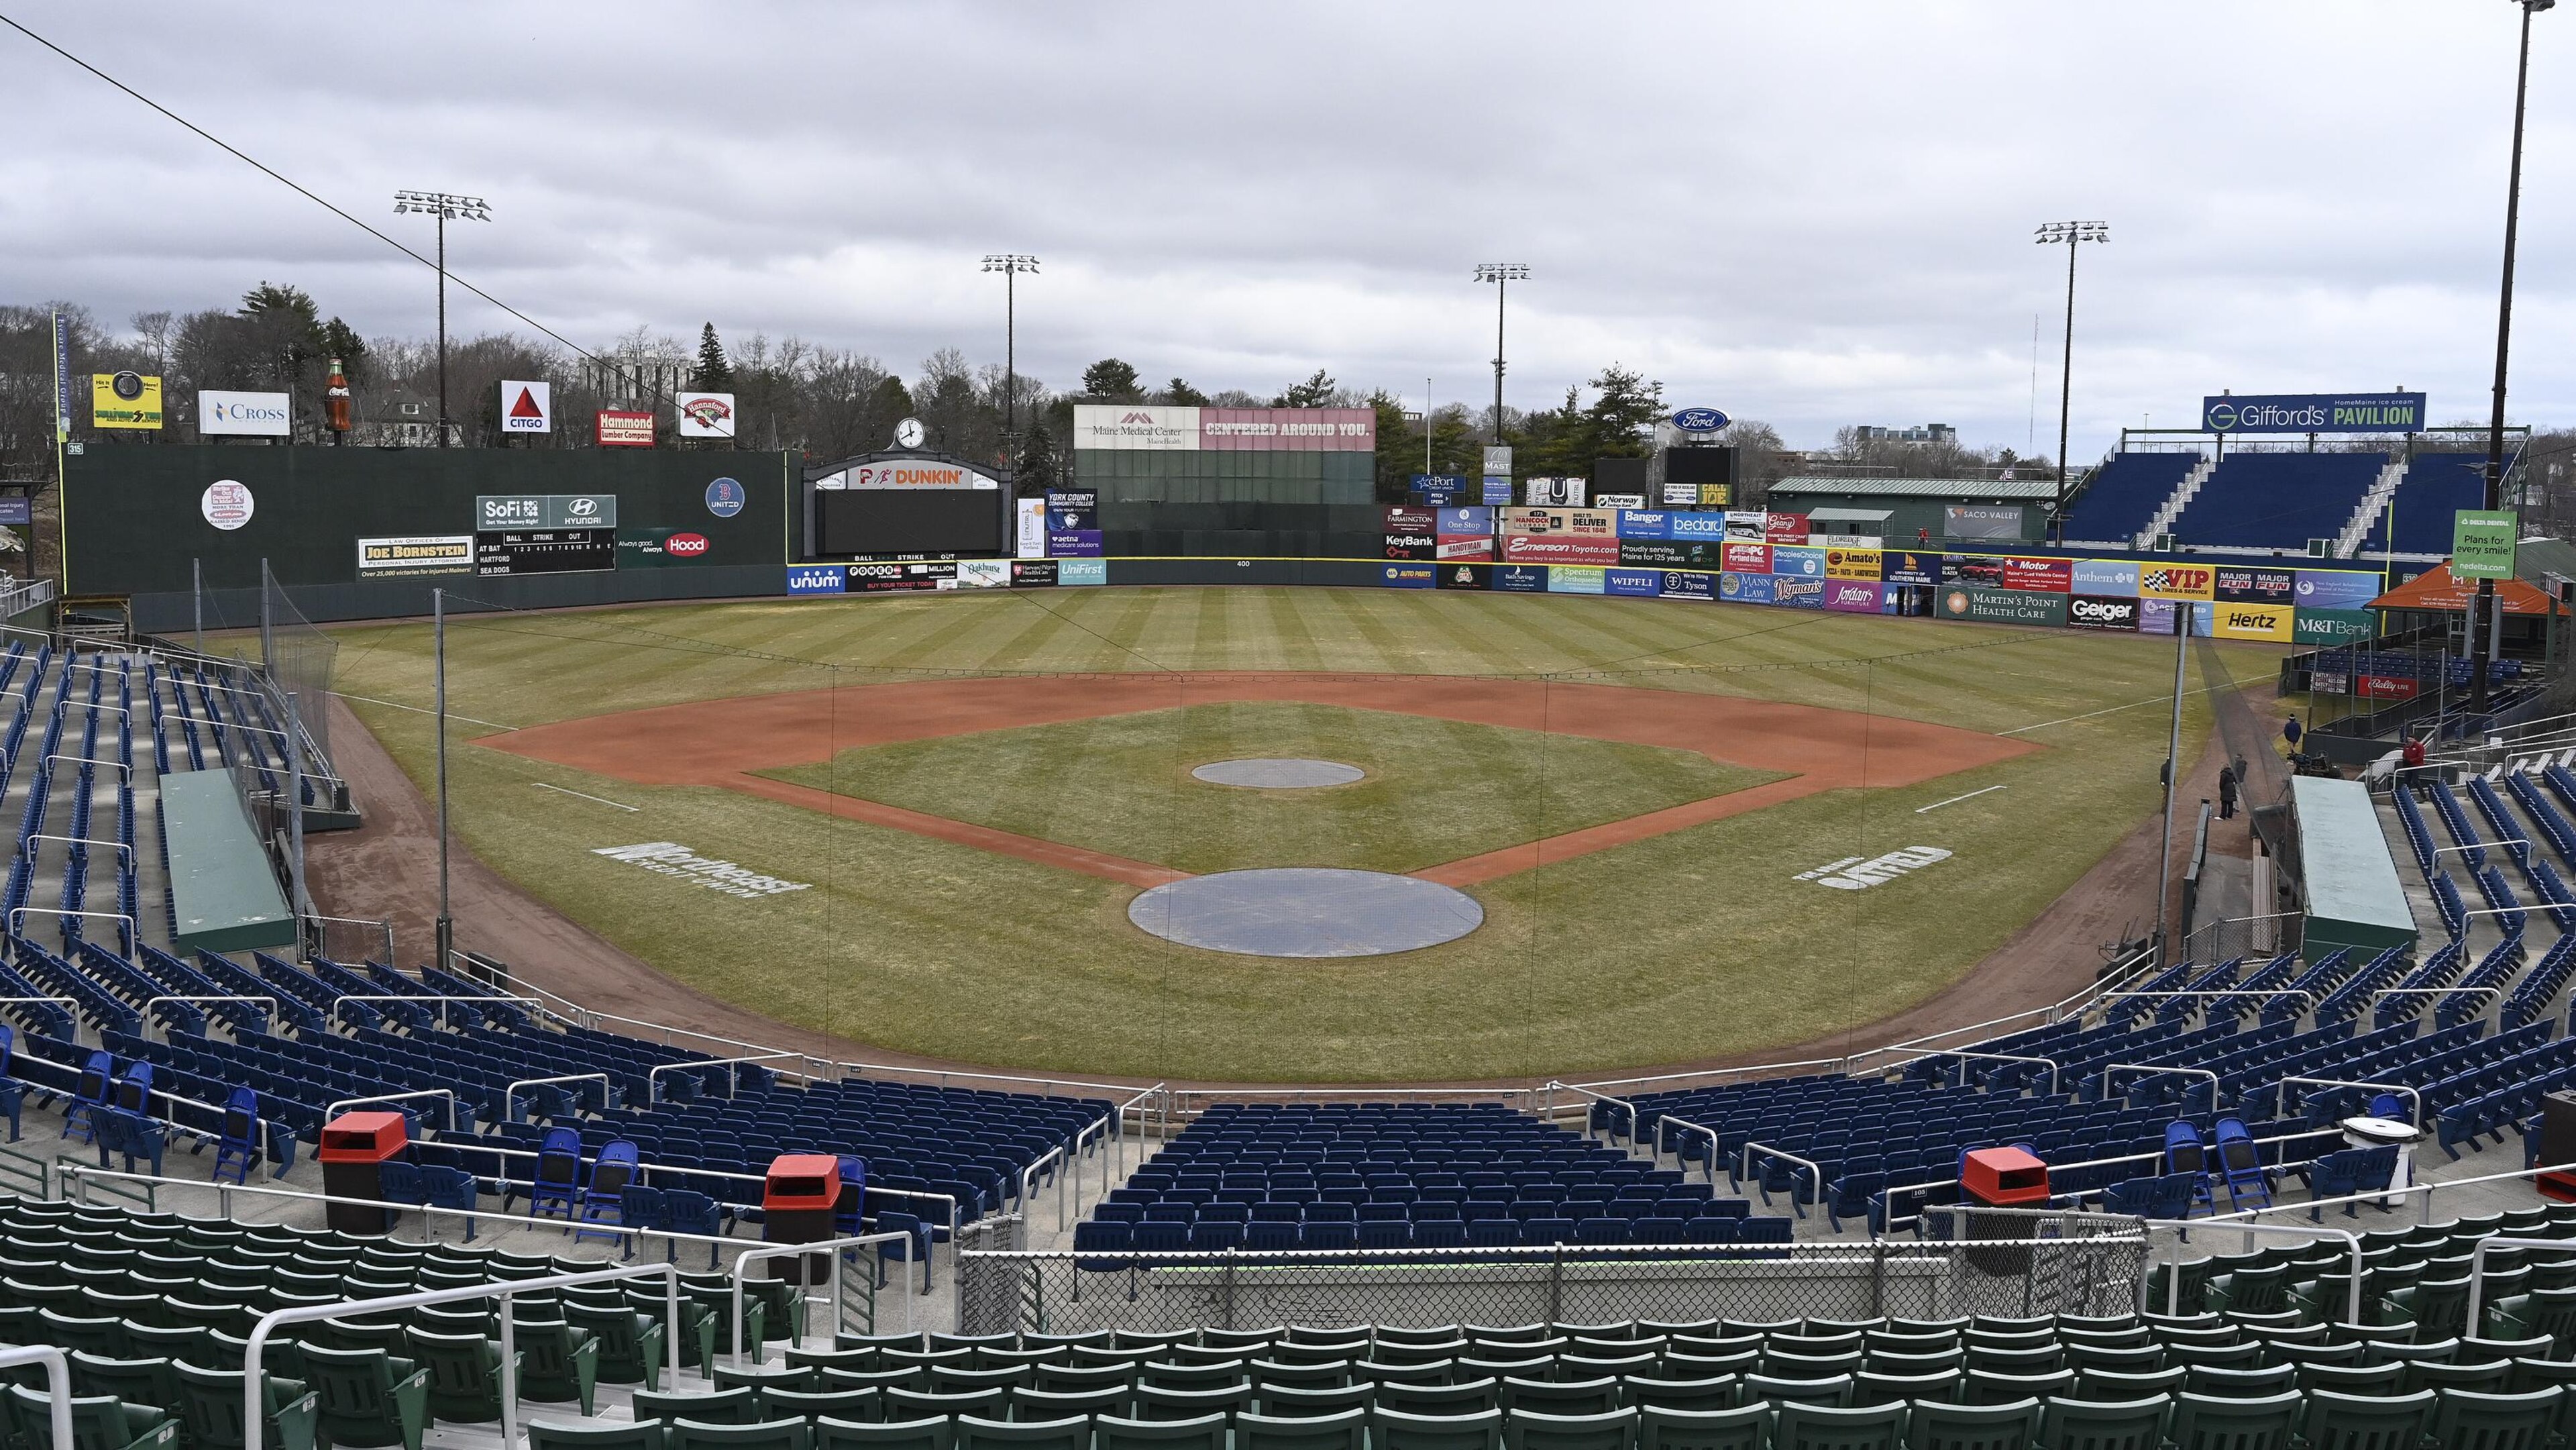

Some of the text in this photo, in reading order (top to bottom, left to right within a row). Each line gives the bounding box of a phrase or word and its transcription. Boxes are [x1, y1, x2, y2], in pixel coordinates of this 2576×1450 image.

[688, 401, 727, 413] Hannaford
[600, 413, 653, 428] Hammond
[1682, 412, 1716, 427] Ford
[2241, 405, 2325, 425] Gifford's
[2333, 407, 2414, 425] PAVILION
[510, 419, 542, 428] CITGO
[1206, 423, 1370, 436] CENTERED AROUND YOU.
[601, 431, 651, 441] Lumber Company
[1092, 425, 1182, 436] Maine Medical Center
[69, 445, 81, 453] 315
[896, 470, 963, 484] DUNKIN'
[1429, 476, 1454, 486] cPort
[1701, 492, 1727, 505] JOE
[486, 501, 521, 517] SoFi
[1625, 511, 1664, 523] Bangor
[1464, 521, 1481, 529] Stop
[1674, 517, 1723, 531] bedard
[670, 539, 704, 550] Hood
[1386, 535, 1433, 548] KeyBank
[1509, 537, 1618, 554] Emerson Toyota.com
[2465, 535, 2505, 545] Plans for
[367, 545, 466, 559] JOE BORNSTEIN
[1448, 542, 1481, 554] HANDYMAN
[1622, 545, 1675, 555] Proudly serving
[2457, 546, 2511, 555] every smile!
[1775, 550, 1823, 559] PeoplesChoice
[1845, 552, 1880, 564] Amato's
[968, 564, 1000, 574] Oakhurst
[1061, 564, 1102, 574] UniFirst
[2019, 561, 2050, 570] Motor
[2459, 564, 2506, 572] nedelta.com
[1564, 568, 1602, 576] Spectrum
[2072, 572, 2113, 582] Anthem
[2220, 572, 2289, 582] MAJOR MAJOR
[1611, 577, 1652, 586] WIPFLI
[1741, 574, 1770, 587] MANN
[2165, 569, 2209, 589] VIP
[1684, 582, 1707, 590] Tyson
[1774, 577, 1822, 601] Wyman's
[1744, 587, 1766, 598] LAW
[1829, 586, 1873, 604] Jordan's
[1972, 593, 2058, 608] MARTIN'S POINT
[1972, 605, 2046, 619] HEALTH CARE
[2072, 600, 2132, 621] Geiger
[2229, 613, 2277, 628] Hertz
[2298, 618, 2371, 635] M&T Bank
[2368, 679, 2396, 692] Bally
[625, 858, 699, 878] CREDIT
[692, 878, 765, 898] UNION
[305, 1398, 313, 1410] H
